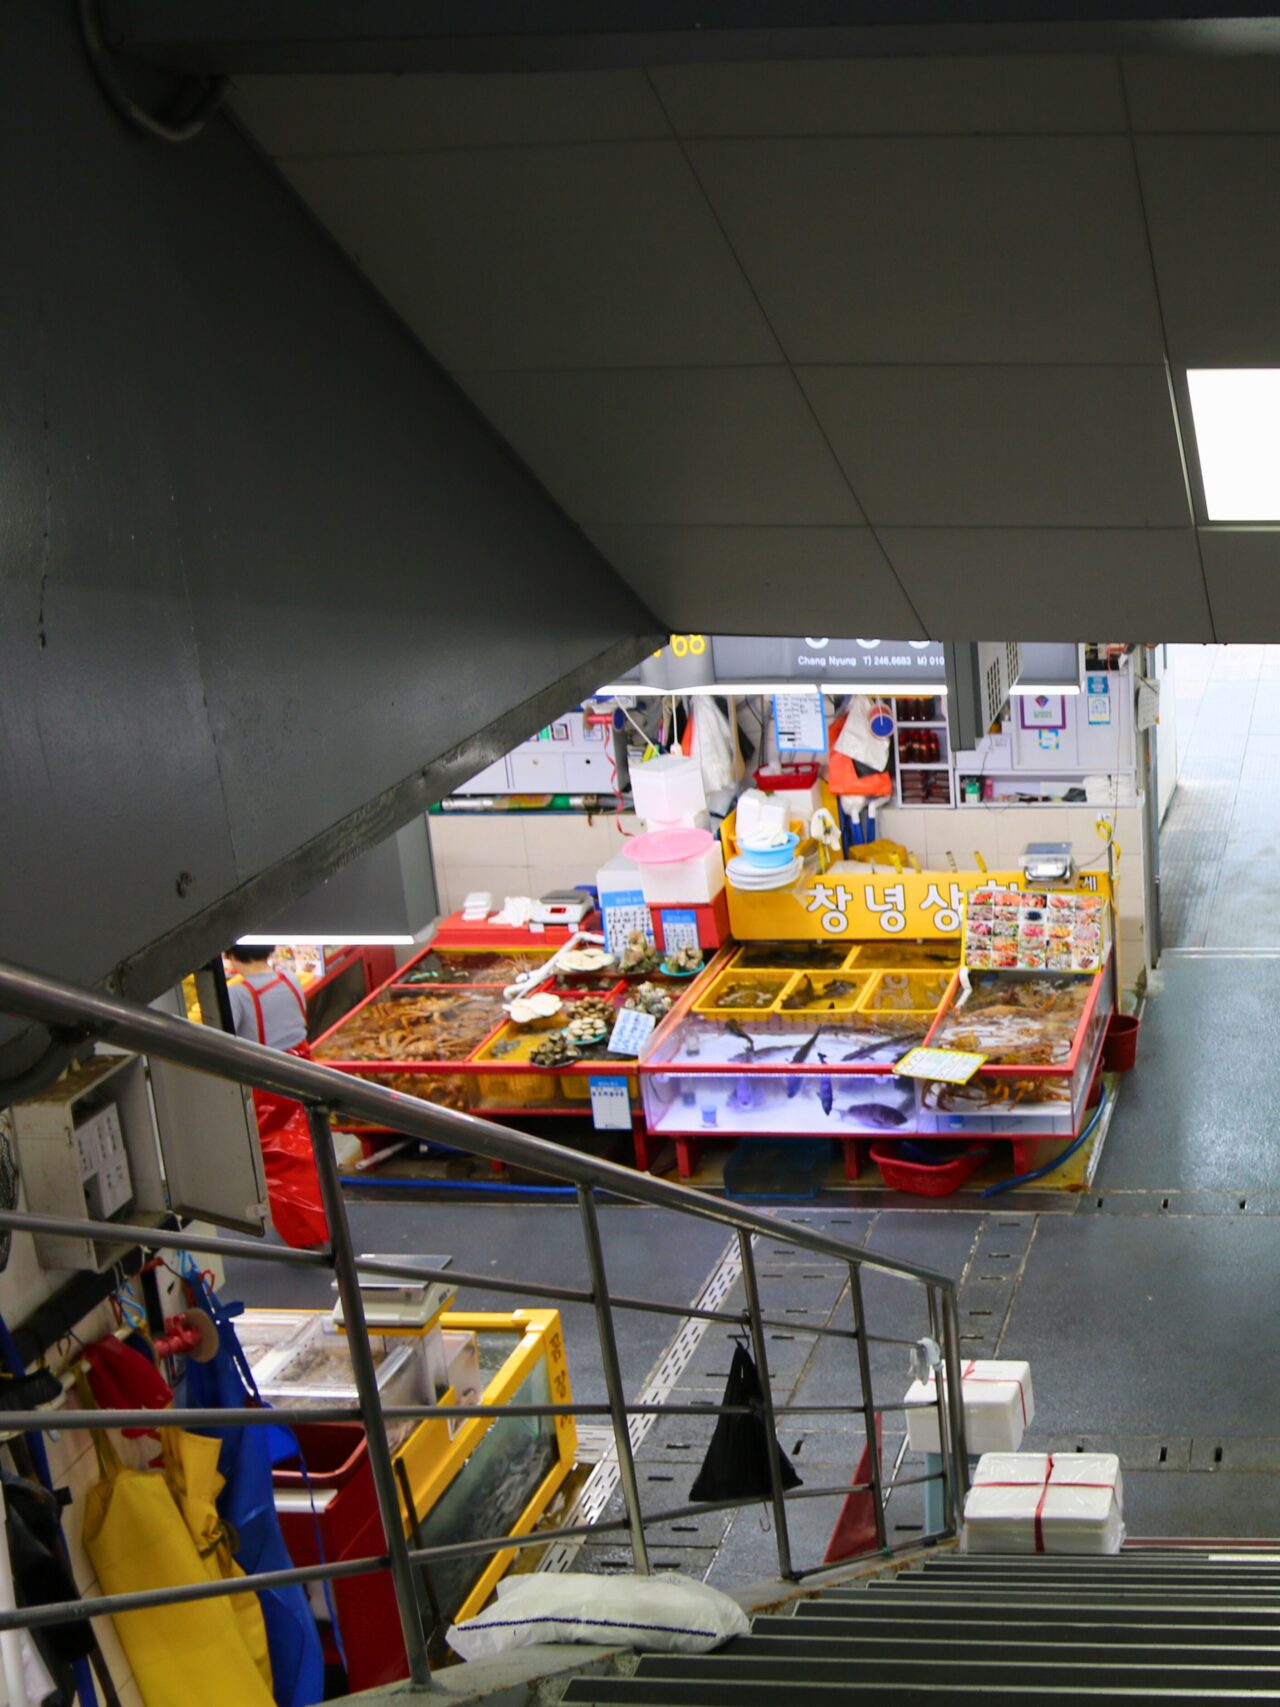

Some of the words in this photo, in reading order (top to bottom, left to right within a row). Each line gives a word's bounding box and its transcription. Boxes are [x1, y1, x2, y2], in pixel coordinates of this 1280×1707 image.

[798, 655, 826, 667] Chang
[828, 655, 857, 668] Nyung
[806, 879, 1019, 934] 창녕상
